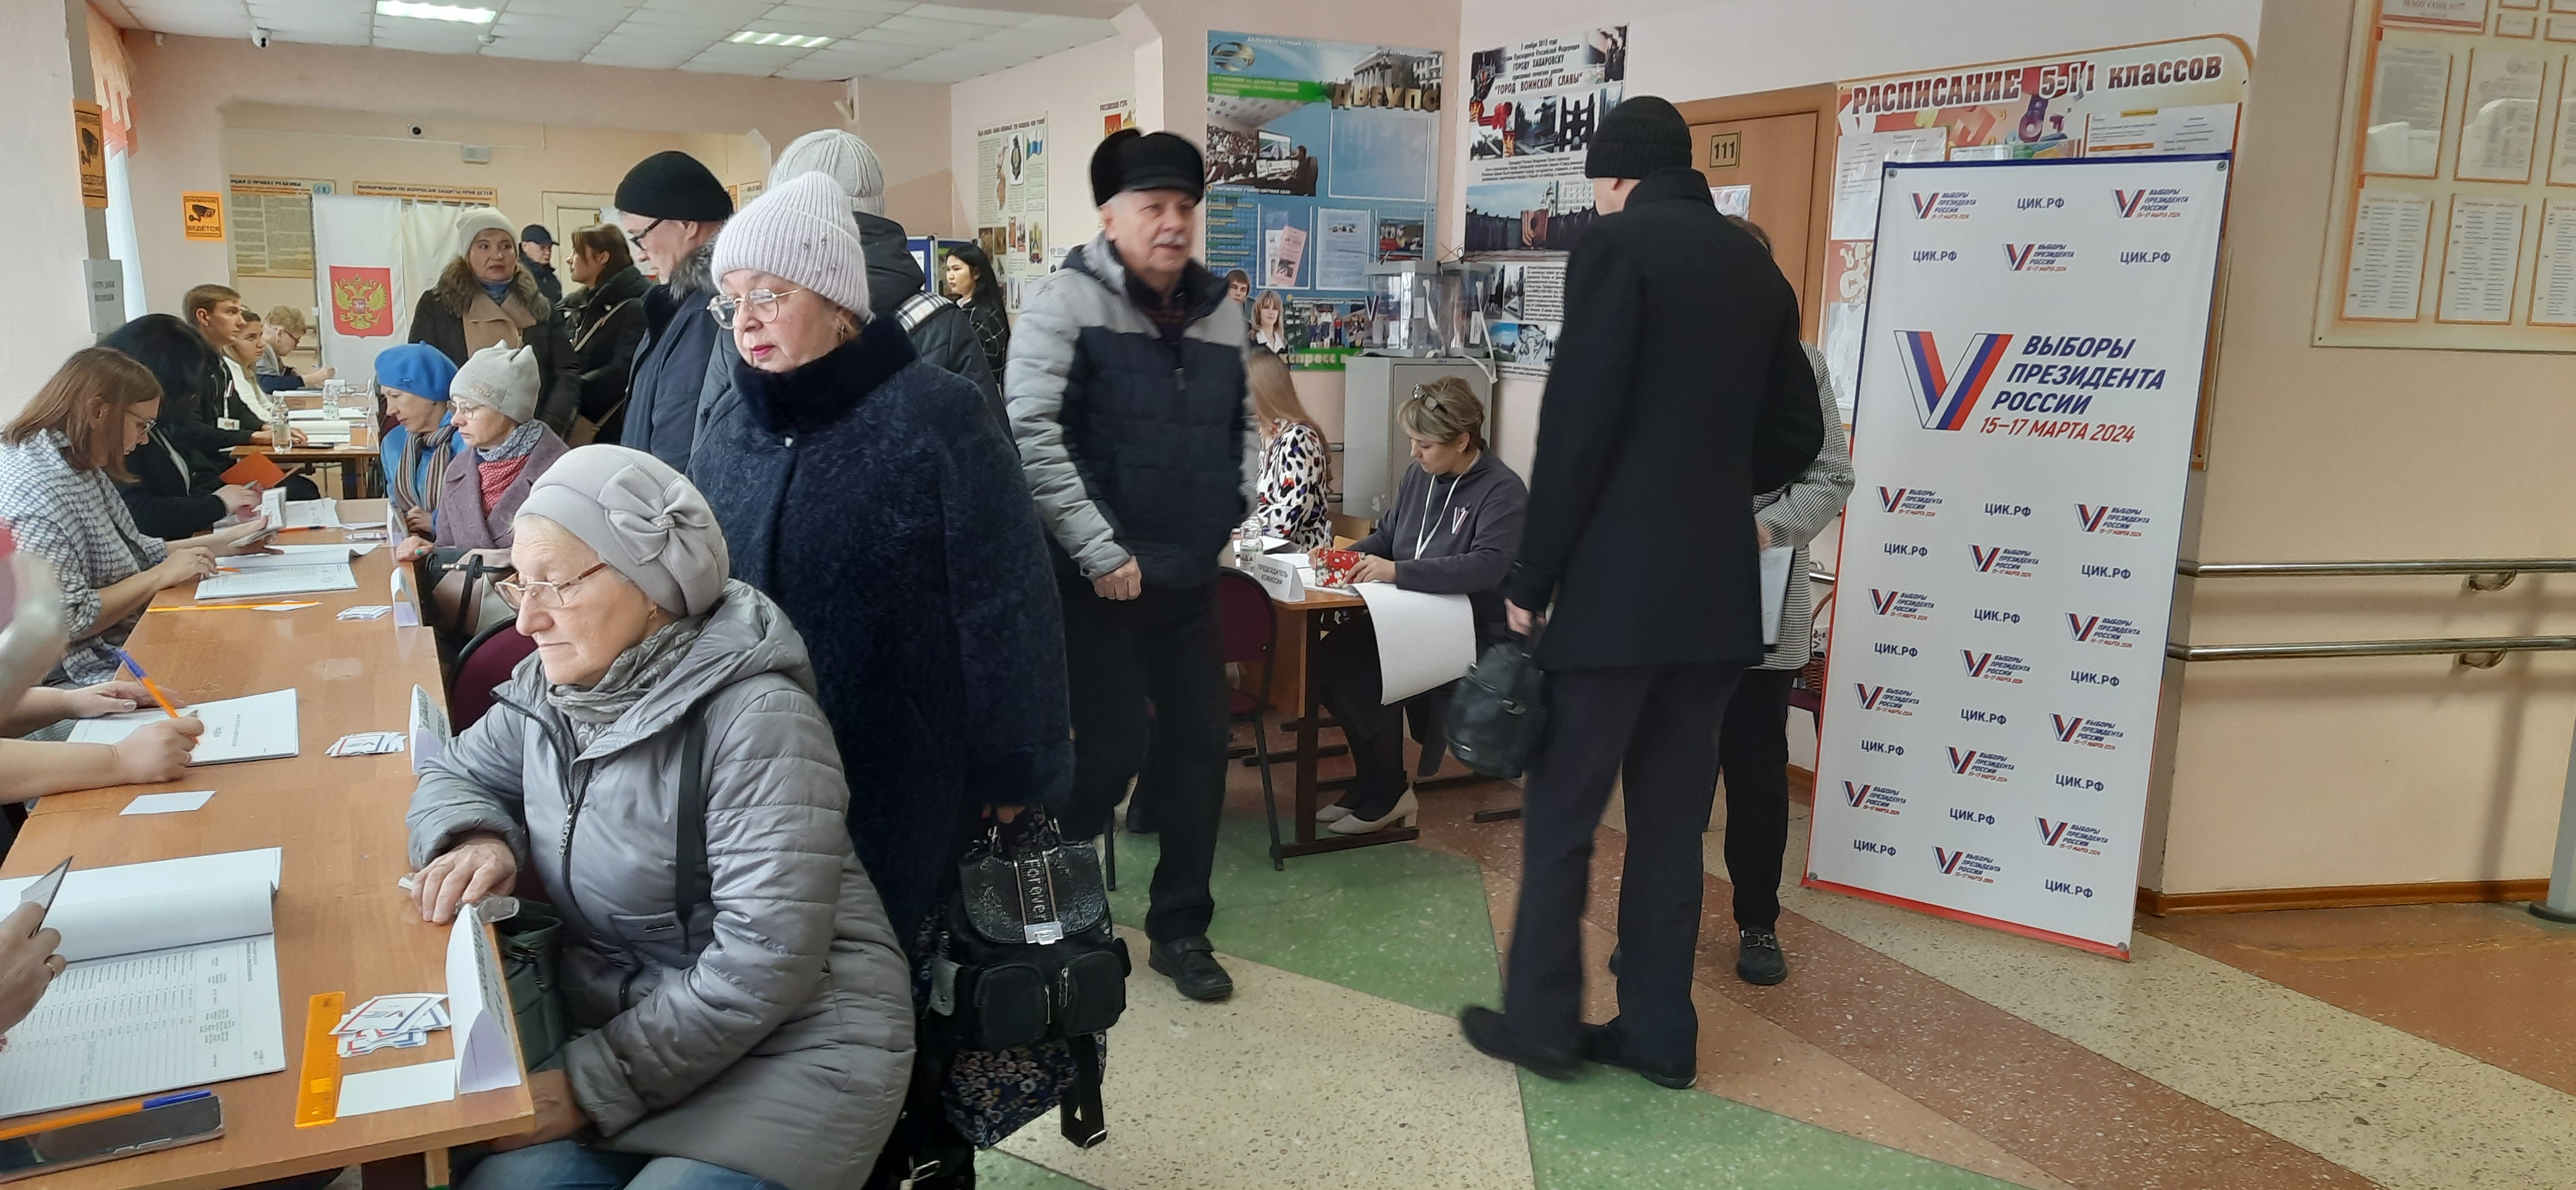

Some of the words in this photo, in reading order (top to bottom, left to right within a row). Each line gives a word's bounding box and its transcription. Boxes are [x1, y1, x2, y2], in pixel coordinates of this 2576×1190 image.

[1520, 77, 1553, 92] ВОИНСКОЙ
[1852, 68, 2022, 115] РАСПИСАНИЕ
[2041, 64, 2095, 96] 5-11
[2108, 56, 2222, 89] классов
[1714, 141, 1735, 159] 111
[2017, 197, 2065, 211] ЦИК.РФ
[1913, 250, 1957, 263] ЦИК.РФ
[2120, 251, 2171, 265] ЦИК.РФ
[2023, 335, 2136, 358] ВЫБОРЫ
[2007, 364, 2166, 389] ПРЕЗИДЕНТА
[1991, 392, 2093, 414] РОССИИ
[2028, 420, 2089, 440] МАРТА
[2090, 425, 2135, 442] 2024
[1984, 503, 2031, 517] ЦИК.РФ
[1884, 543, 1928, 557] ЦИК.РФ
[2081, 564, 2131, 579] ЦИК.РФ
[1974, 608, 2020, 623] ЦИК.РФ
[1875, 642, 1918, 657] ЦИК.РФ
[2071, 670, 2120, 686] ЦИК.РФ
[1961, 709, 2006, 725] ЦИК.РФ
[1861, 740, 1904, 756] ЦИК.РФ
[2055, 774, 2104, 792] ЦИК.РФ
[1950, 808, 1995, 825] ЦИК.РФ
[1853, 839, 1896, 856] ЦИК.РФ
[2045, 879, 2093, 898] ЦИК.РФ
